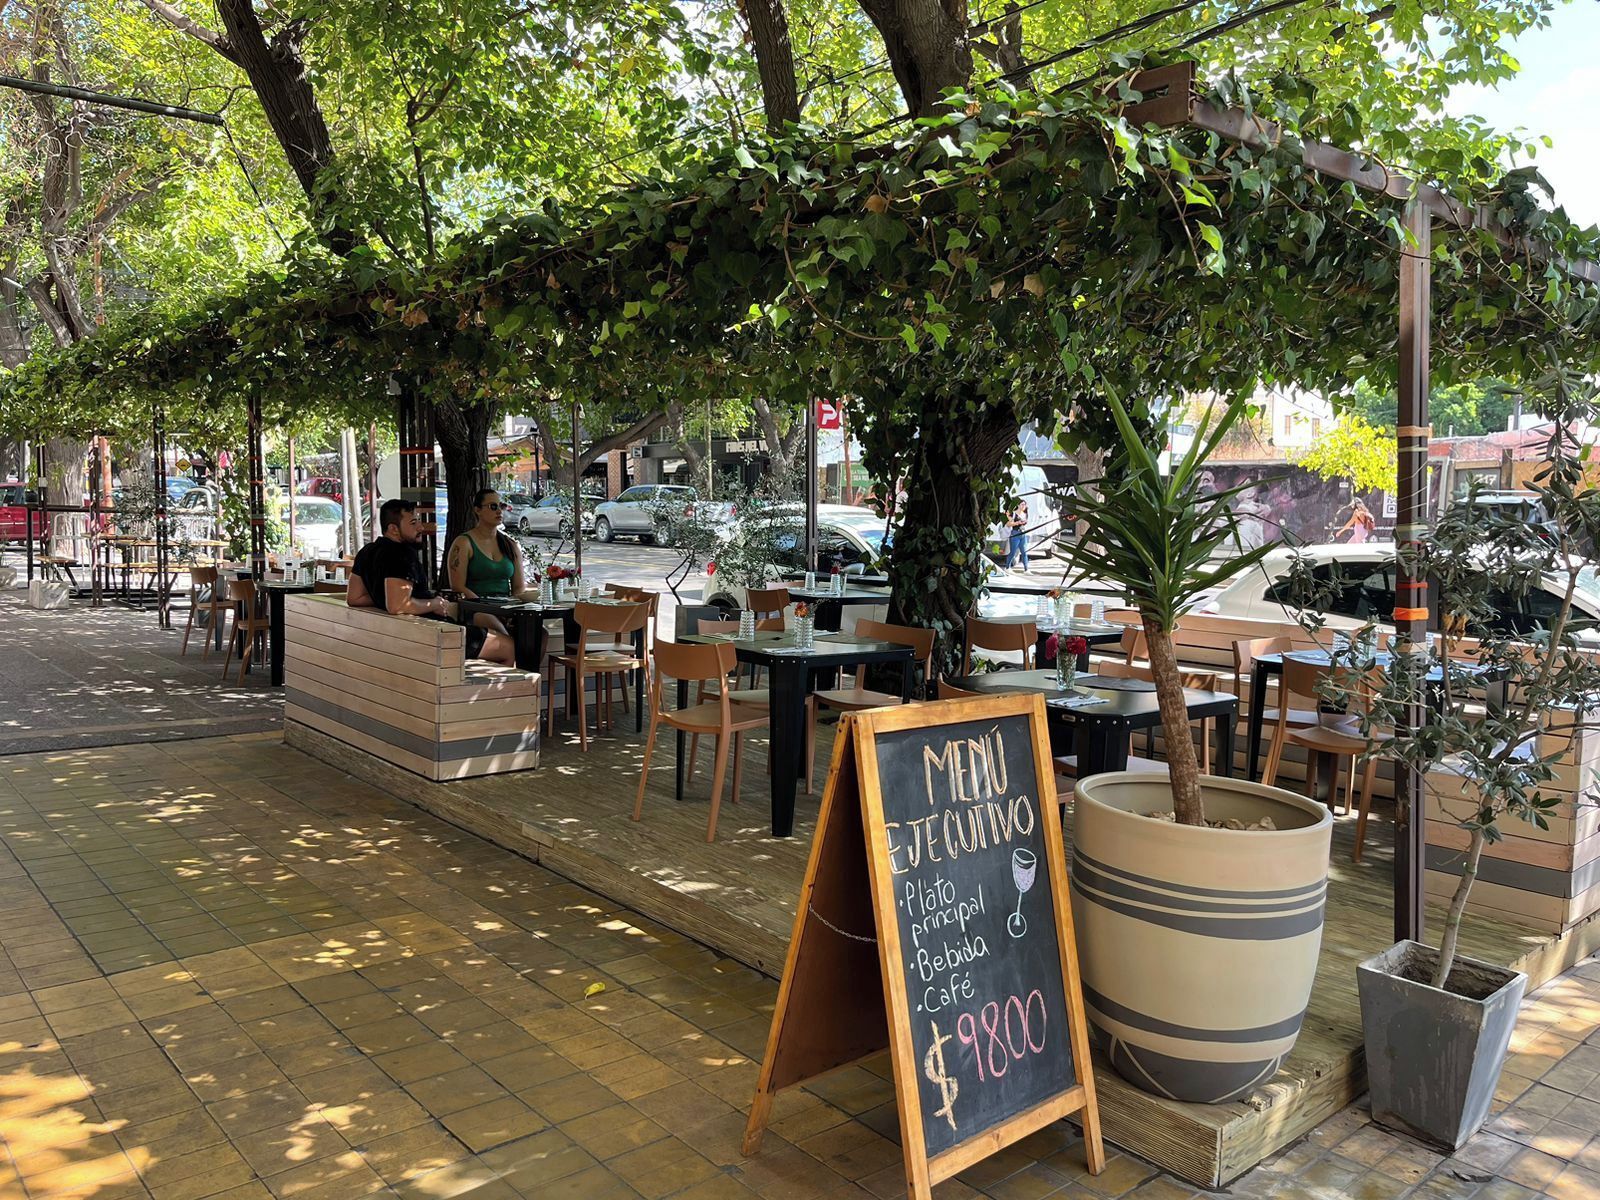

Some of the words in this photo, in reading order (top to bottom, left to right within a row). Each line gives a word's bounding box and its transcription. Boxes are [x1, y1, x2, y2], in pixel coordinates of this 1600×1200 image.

[922, 724, 1008, 805] MENÚ
[884, 794, 1035, 875] EJECUTIVO
[905, 873, 956, 917] Plato
[911, 883, 987, 948] principal
[916, 935, 990, 982] Bebida
